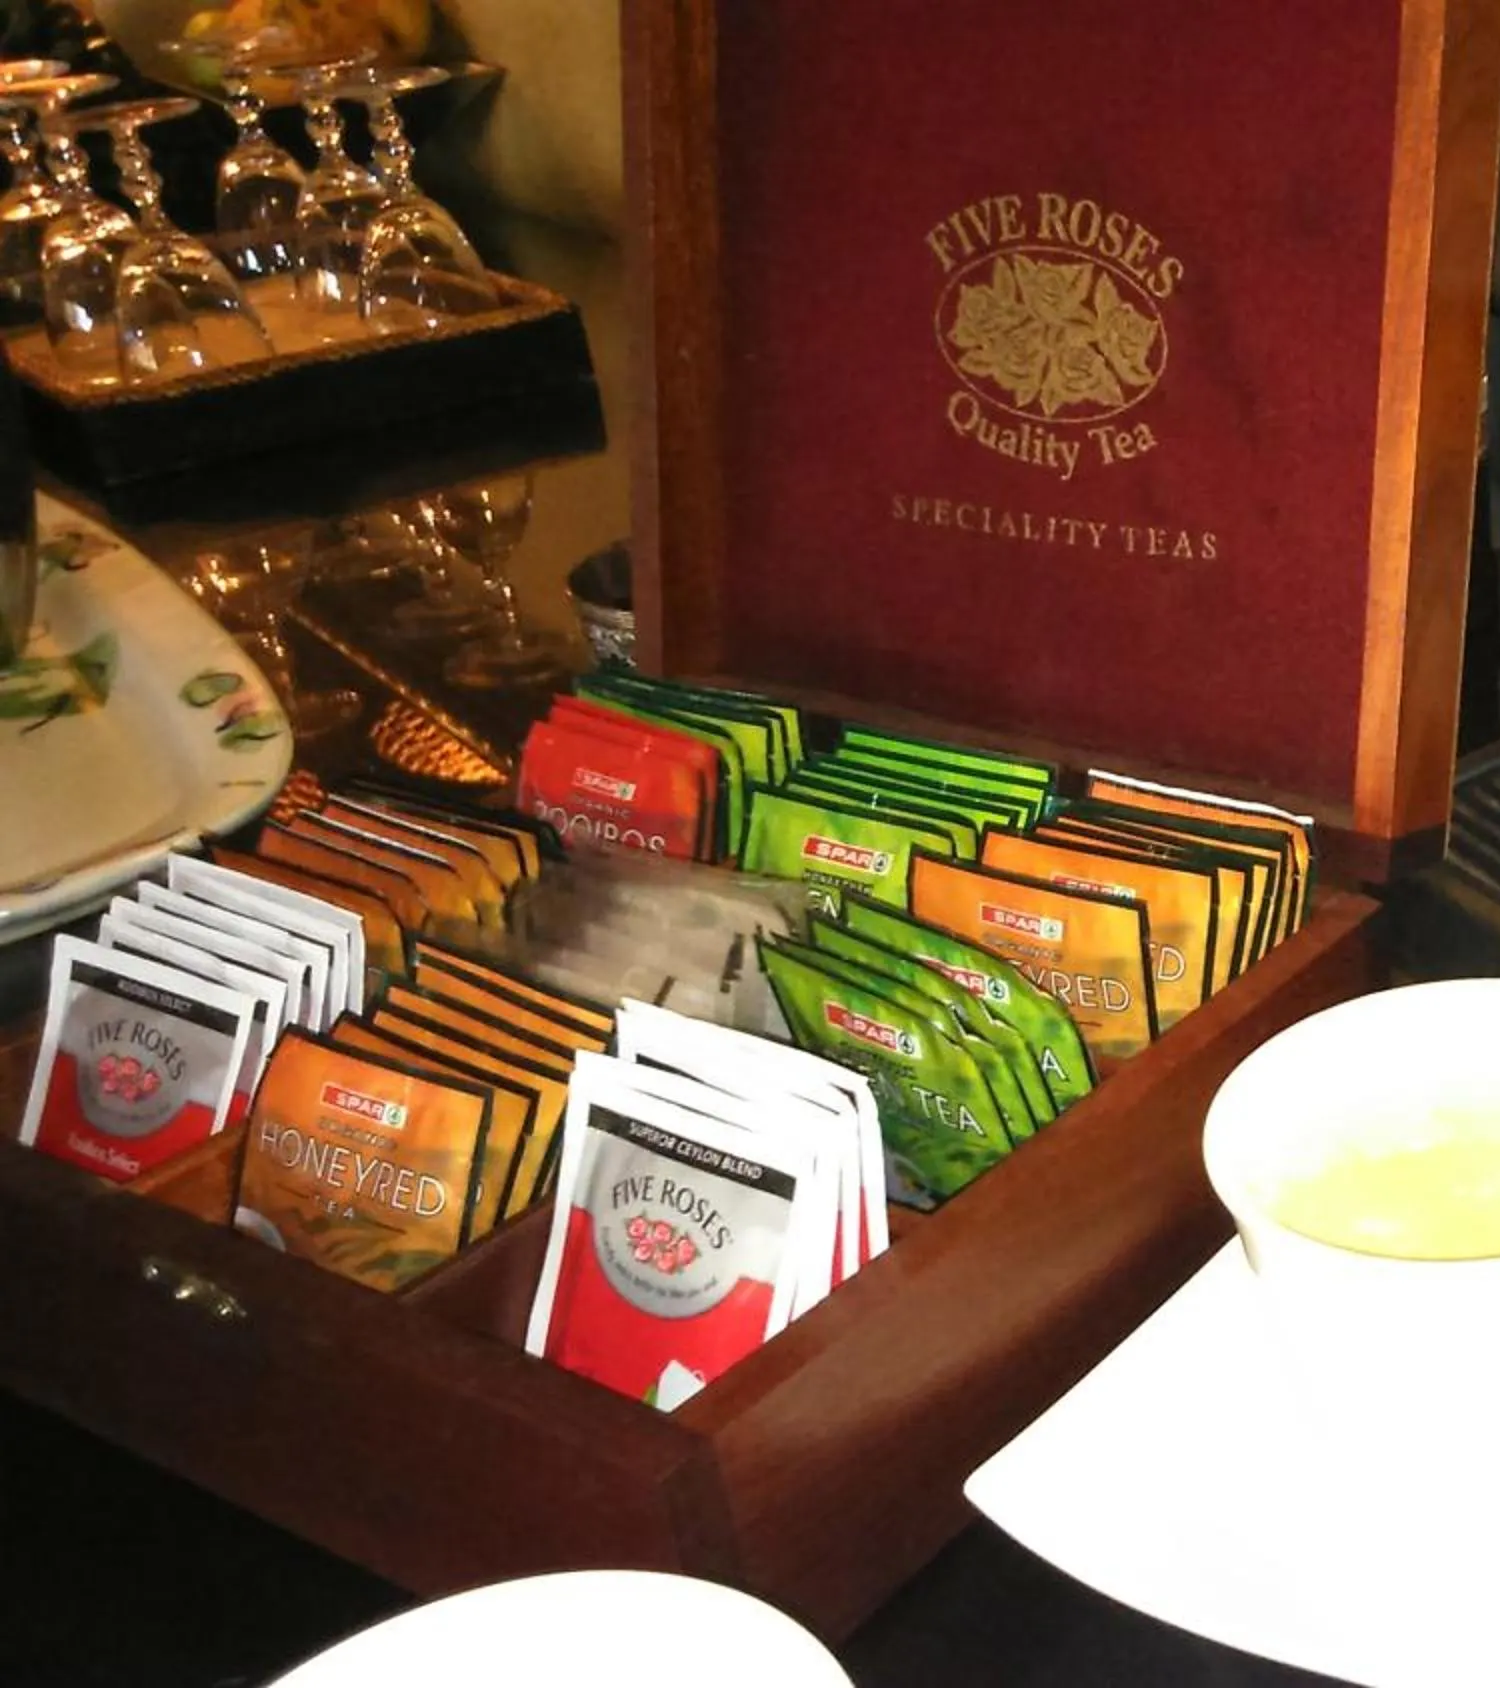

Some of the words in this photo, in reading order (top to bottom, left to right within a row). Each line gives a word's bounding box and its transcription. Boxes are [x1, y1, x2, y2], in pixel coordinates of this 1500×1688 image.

[925, 194, 1027, 273] FIVE
[1036, 192, 1185, 299] ROSES
[945, 391, 1081, 480] Quality
[1087, 422, 1158, 466] Tea
[890, 495, 1108, 550] SPECIALITY
[1119, 526, 1219, 561] TEAS
[816, 842, 872, 867] SPAR
[993, 911, 1042, 935] SPAR
[87, 1018, 126, 1050] FIVE
[131, 1020, 188, 1082] ROSES
[335, 1091, 385, 1121] SPAR
[912, 1085, 986, 1137] TEA
[258, 1120, 446, 1216] HONEYRED
[630, 1121, 677, 1150] SUPERIOR
[676, 1139, 722, 1167] CEYLON
[720, 1155, 763, 1180] BLEND
[612, 1174, 655, 1210] FIVE
[660, 1178, 731, 1249] ROSES
